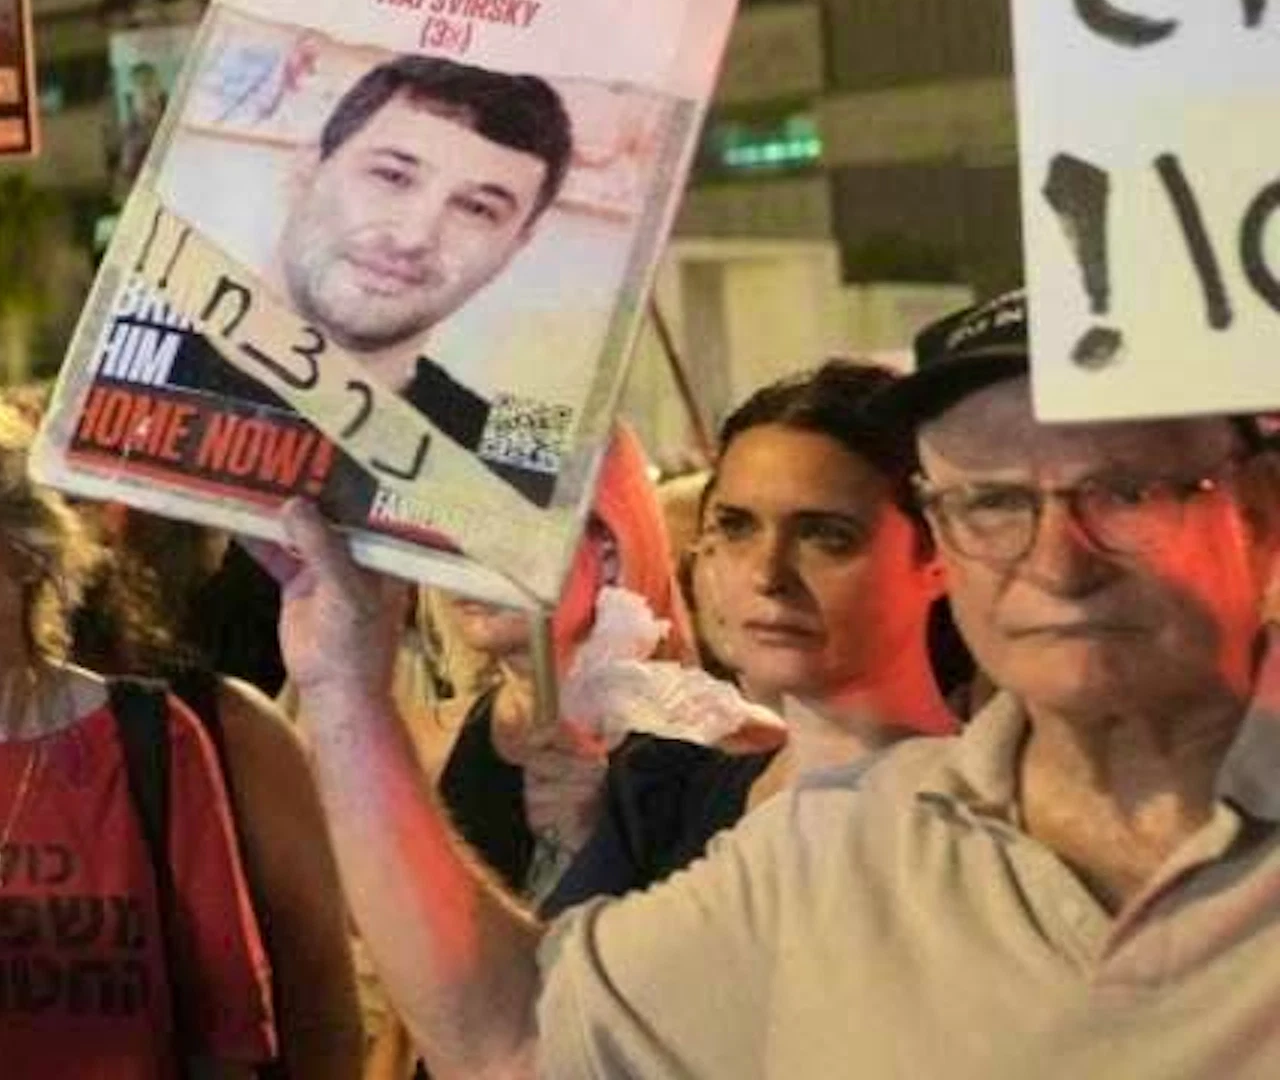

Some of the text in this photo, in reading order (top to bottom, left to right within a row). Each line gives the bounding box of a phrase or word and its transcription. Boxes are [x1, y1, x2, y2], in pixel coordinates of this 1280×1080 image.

[95, 322, 182, 386] HIM
[77, 385, 336, 495] HOME NOW!
